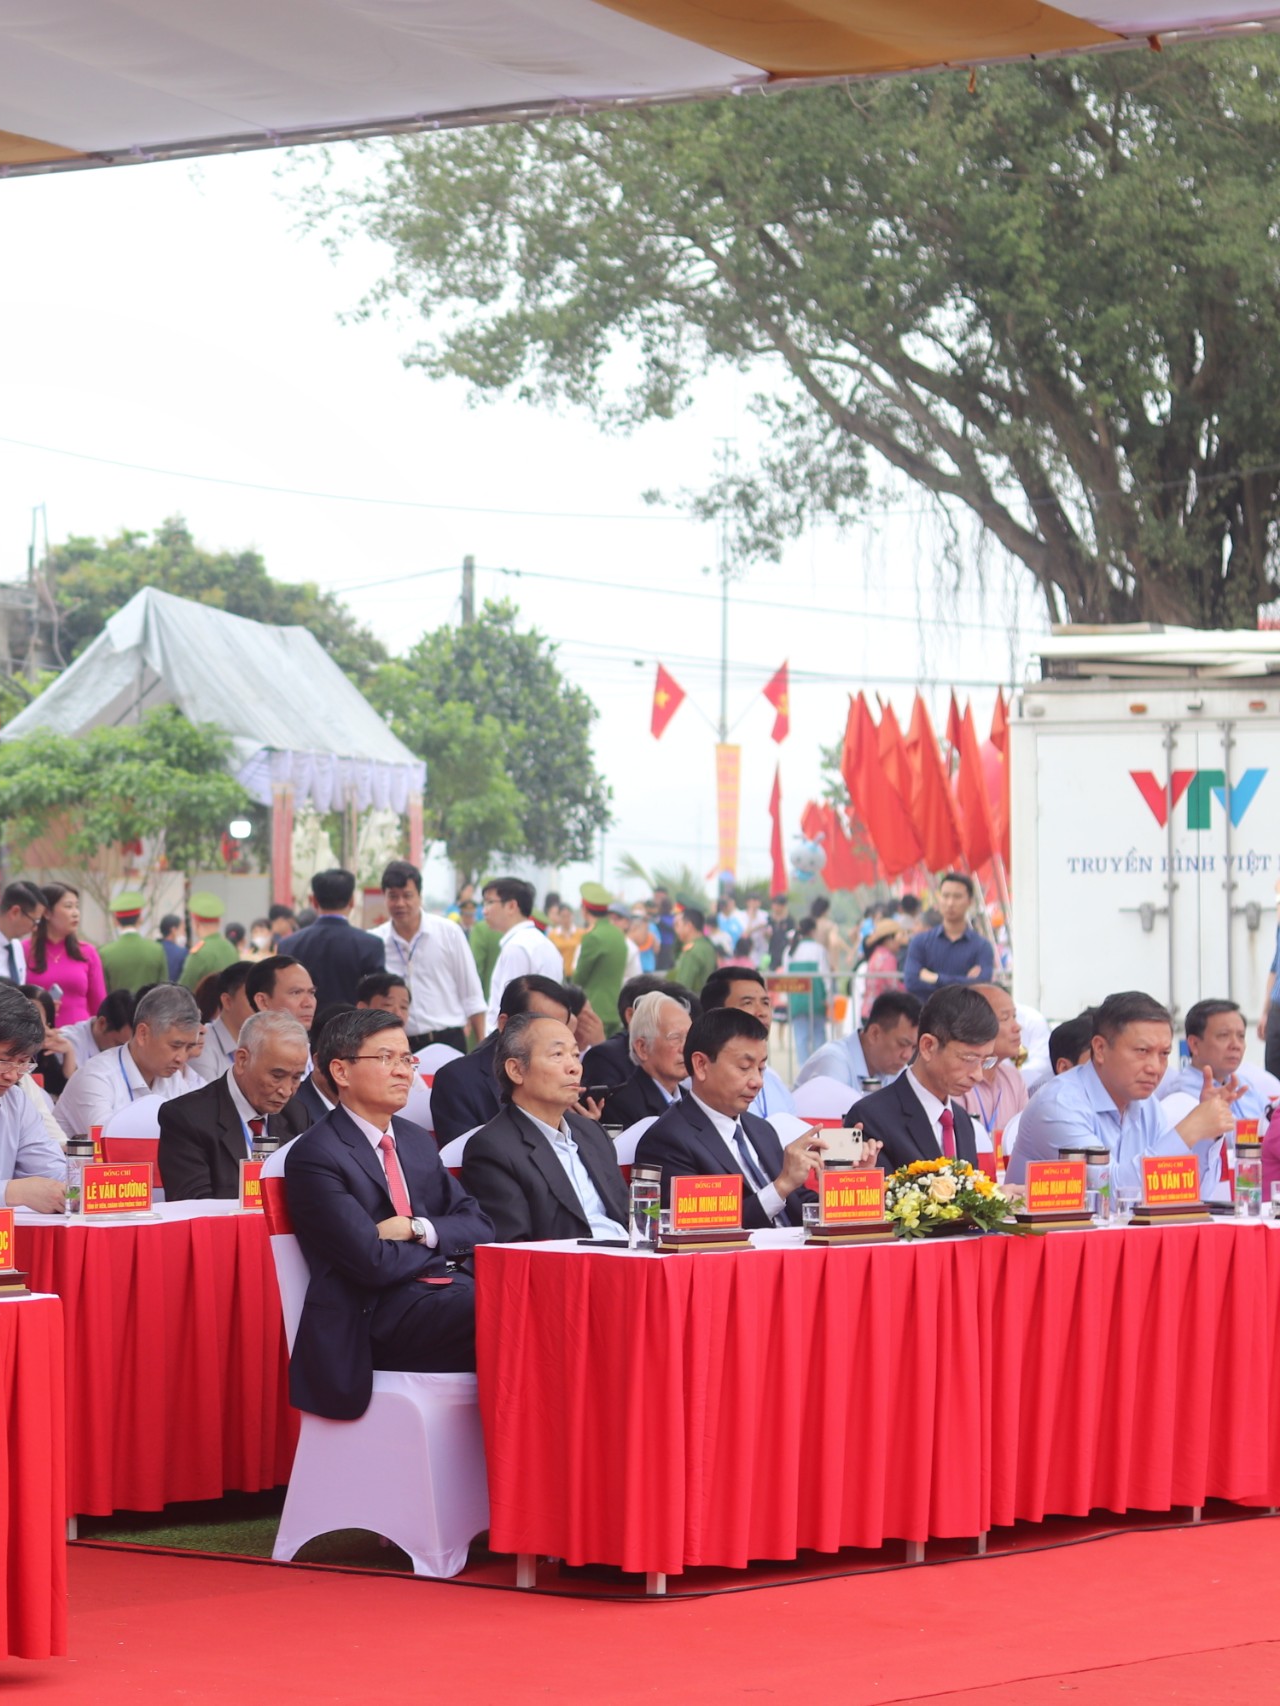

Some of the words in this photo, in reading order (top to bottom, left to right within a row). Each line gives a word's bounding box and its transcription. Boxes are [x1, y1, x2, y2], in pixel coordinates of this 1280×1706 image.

[1129, 768, 1268, 830] VTV
[1067, 847, 1153, 874] TRUYỀN
[87, 1182, 97, 1200] LÊ
[99, 1181, 117, 1199] VĂN
[119, 1179, 147, 1198] CƯỜNG
[1161, 1170, 1180, 1190] VĂN
[678, 1194, 697, 1213] ĐOÀN
[699, 1196, 717, 1212] MINH
[719, 1190, 737, 1212] HUẤN
